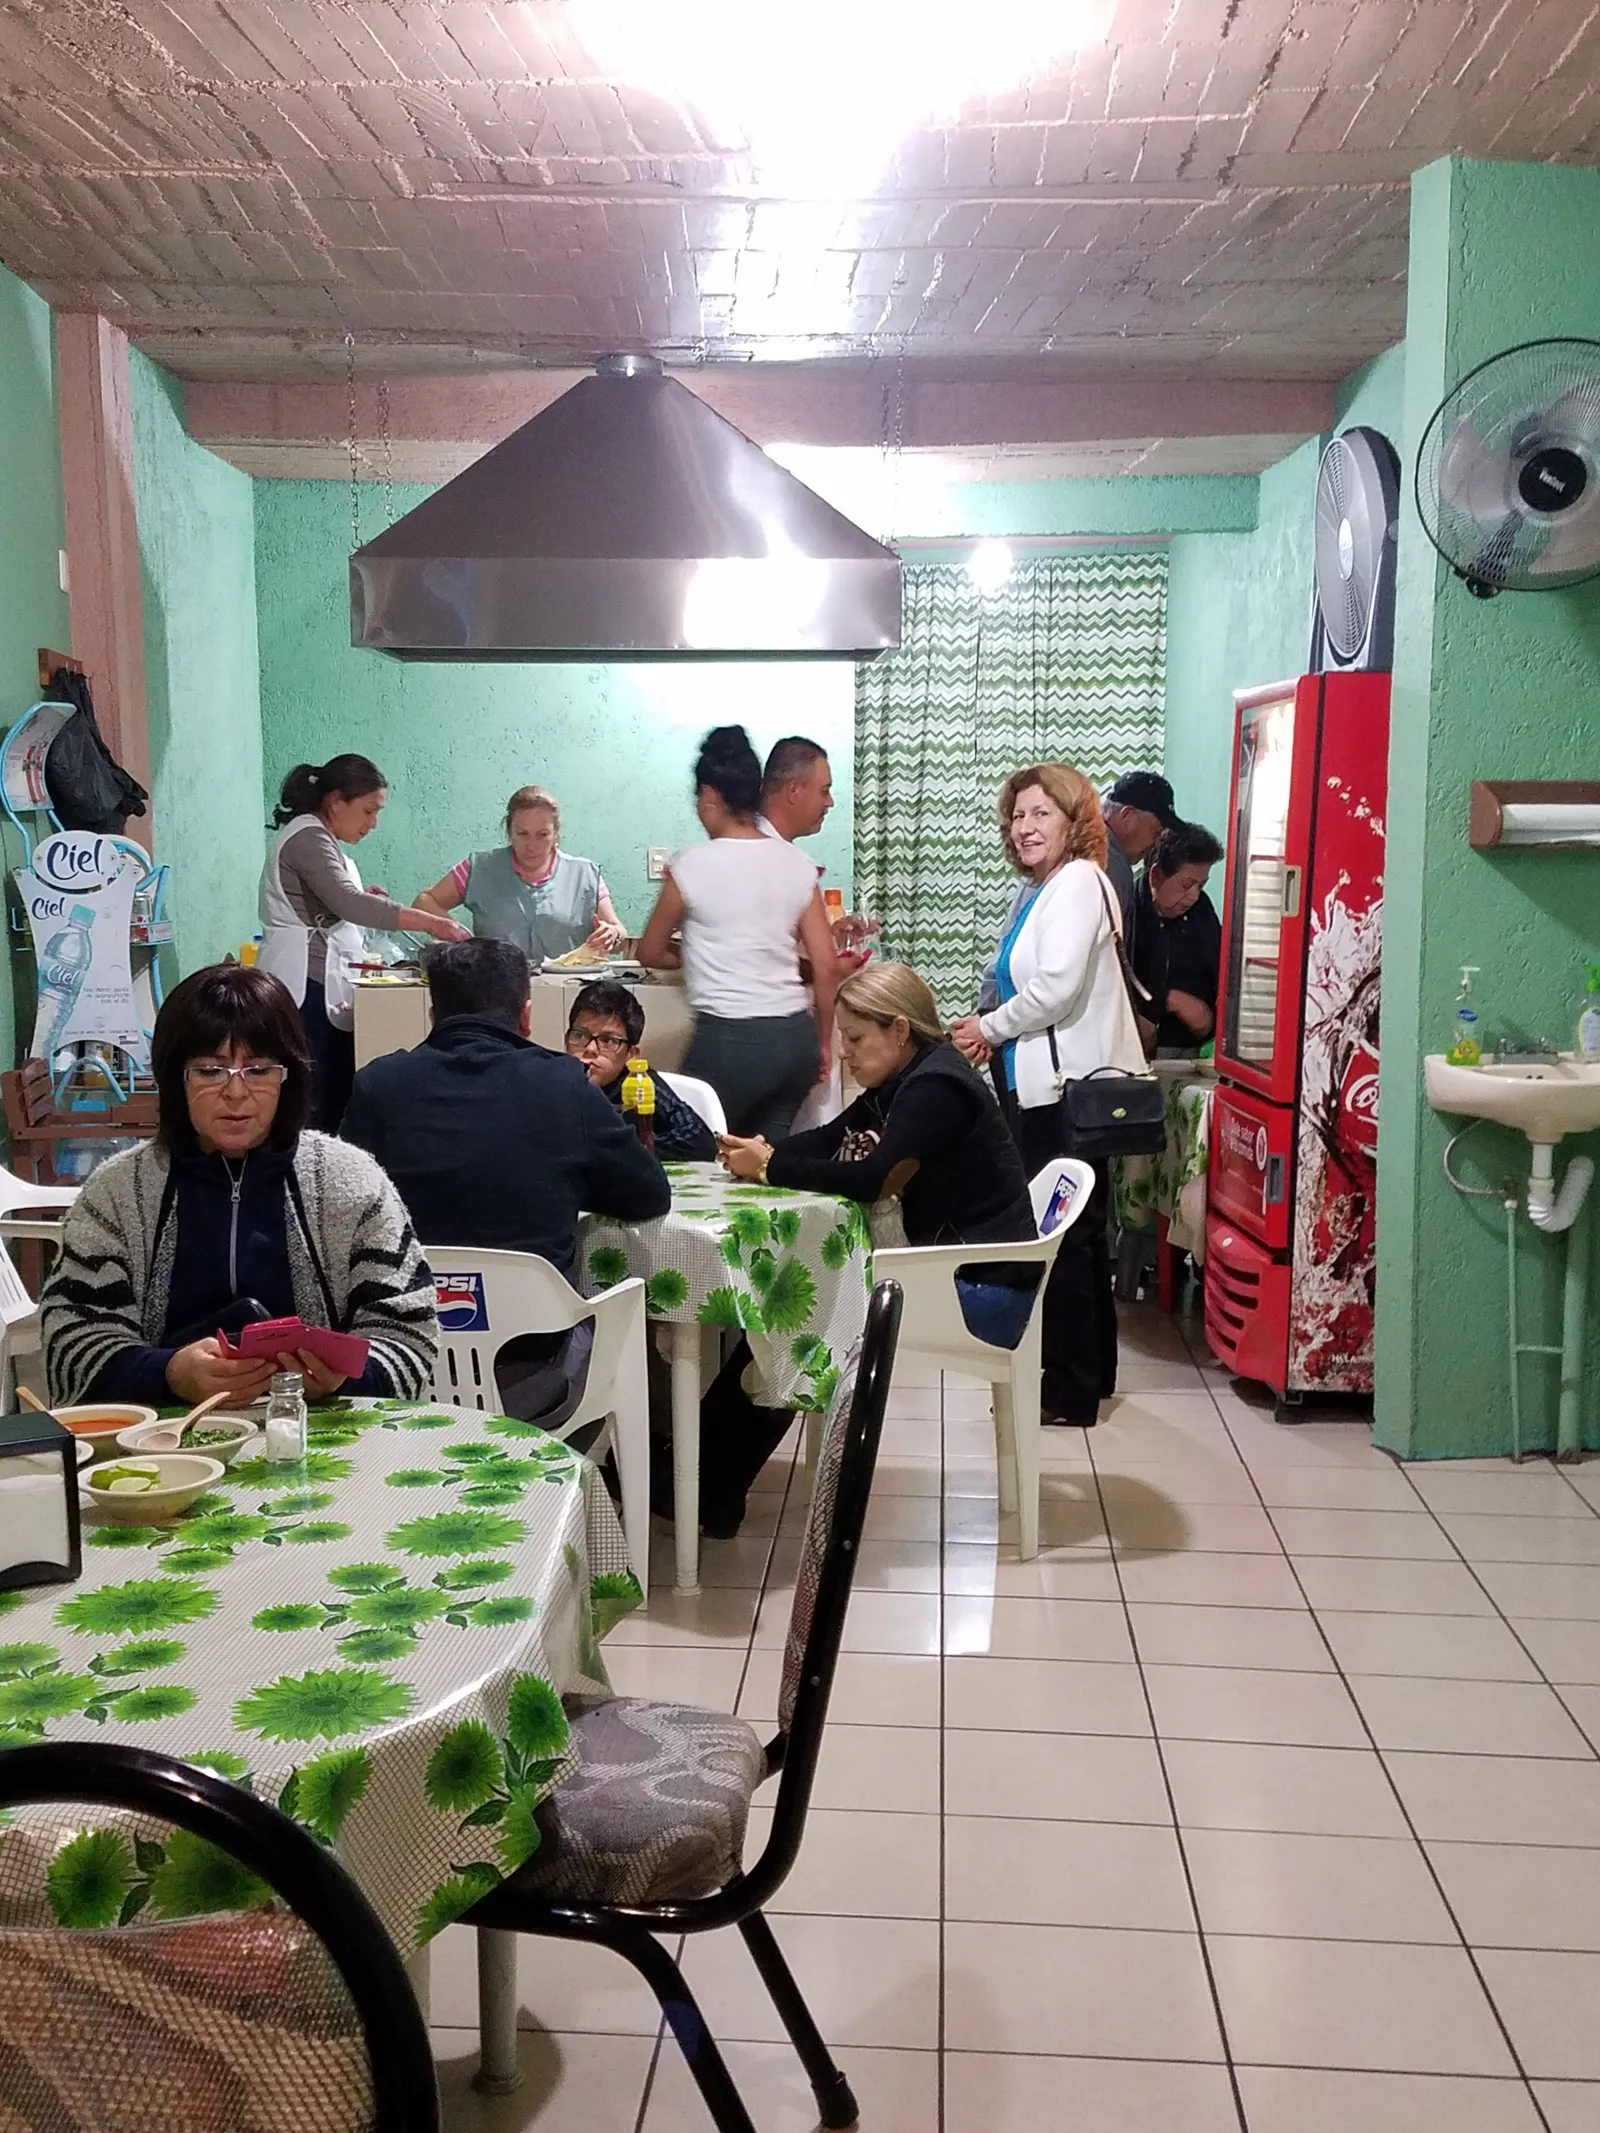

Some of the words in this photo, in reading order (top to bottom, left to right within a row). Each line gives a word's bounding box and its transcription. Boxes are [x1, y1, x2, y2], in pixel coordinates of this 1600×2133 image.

[47, 839, 103, 880] Ciel
[32, 897, 65, 920] Ciel
[47, 964, 80, 985] Ciel
[432, 1276, 477, 1292] PSI
